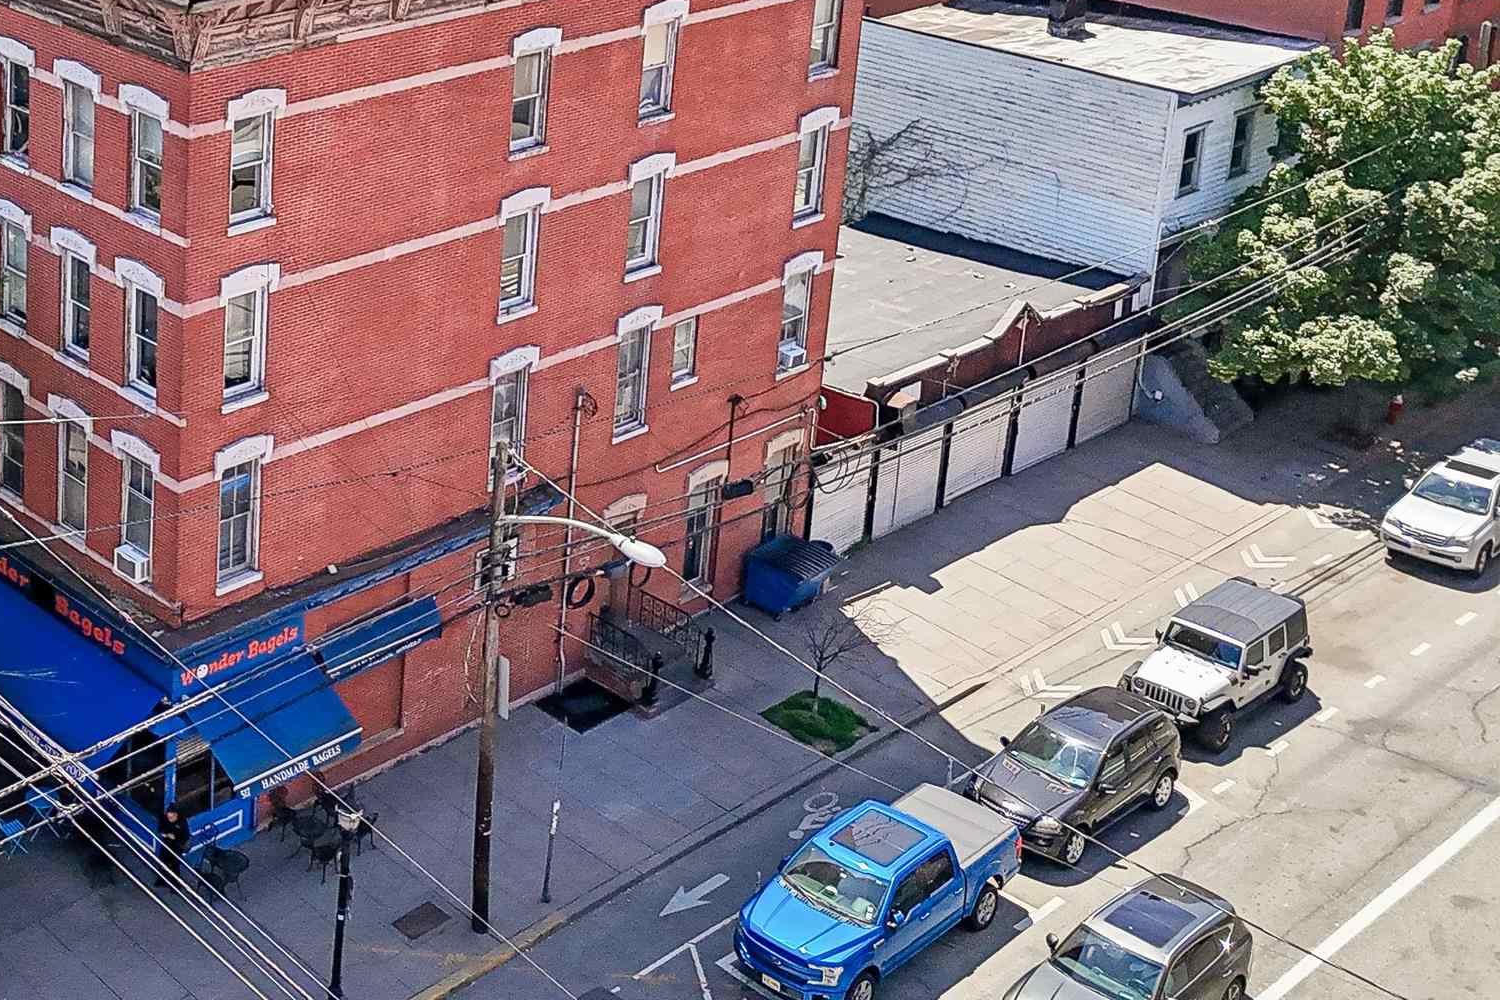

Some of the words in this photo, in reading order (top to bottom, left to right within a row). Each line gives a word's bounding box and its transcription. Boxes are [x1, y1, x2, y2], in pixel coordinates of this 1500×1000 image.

[54, 594, 126, 655] Bagels
[180, 649, 245, 686] Wonder
[247, 626, 299, 659] Bagels
[261, 759, 310, 790] HANDMADE
[311, 744, 341, 766] BAGELS
